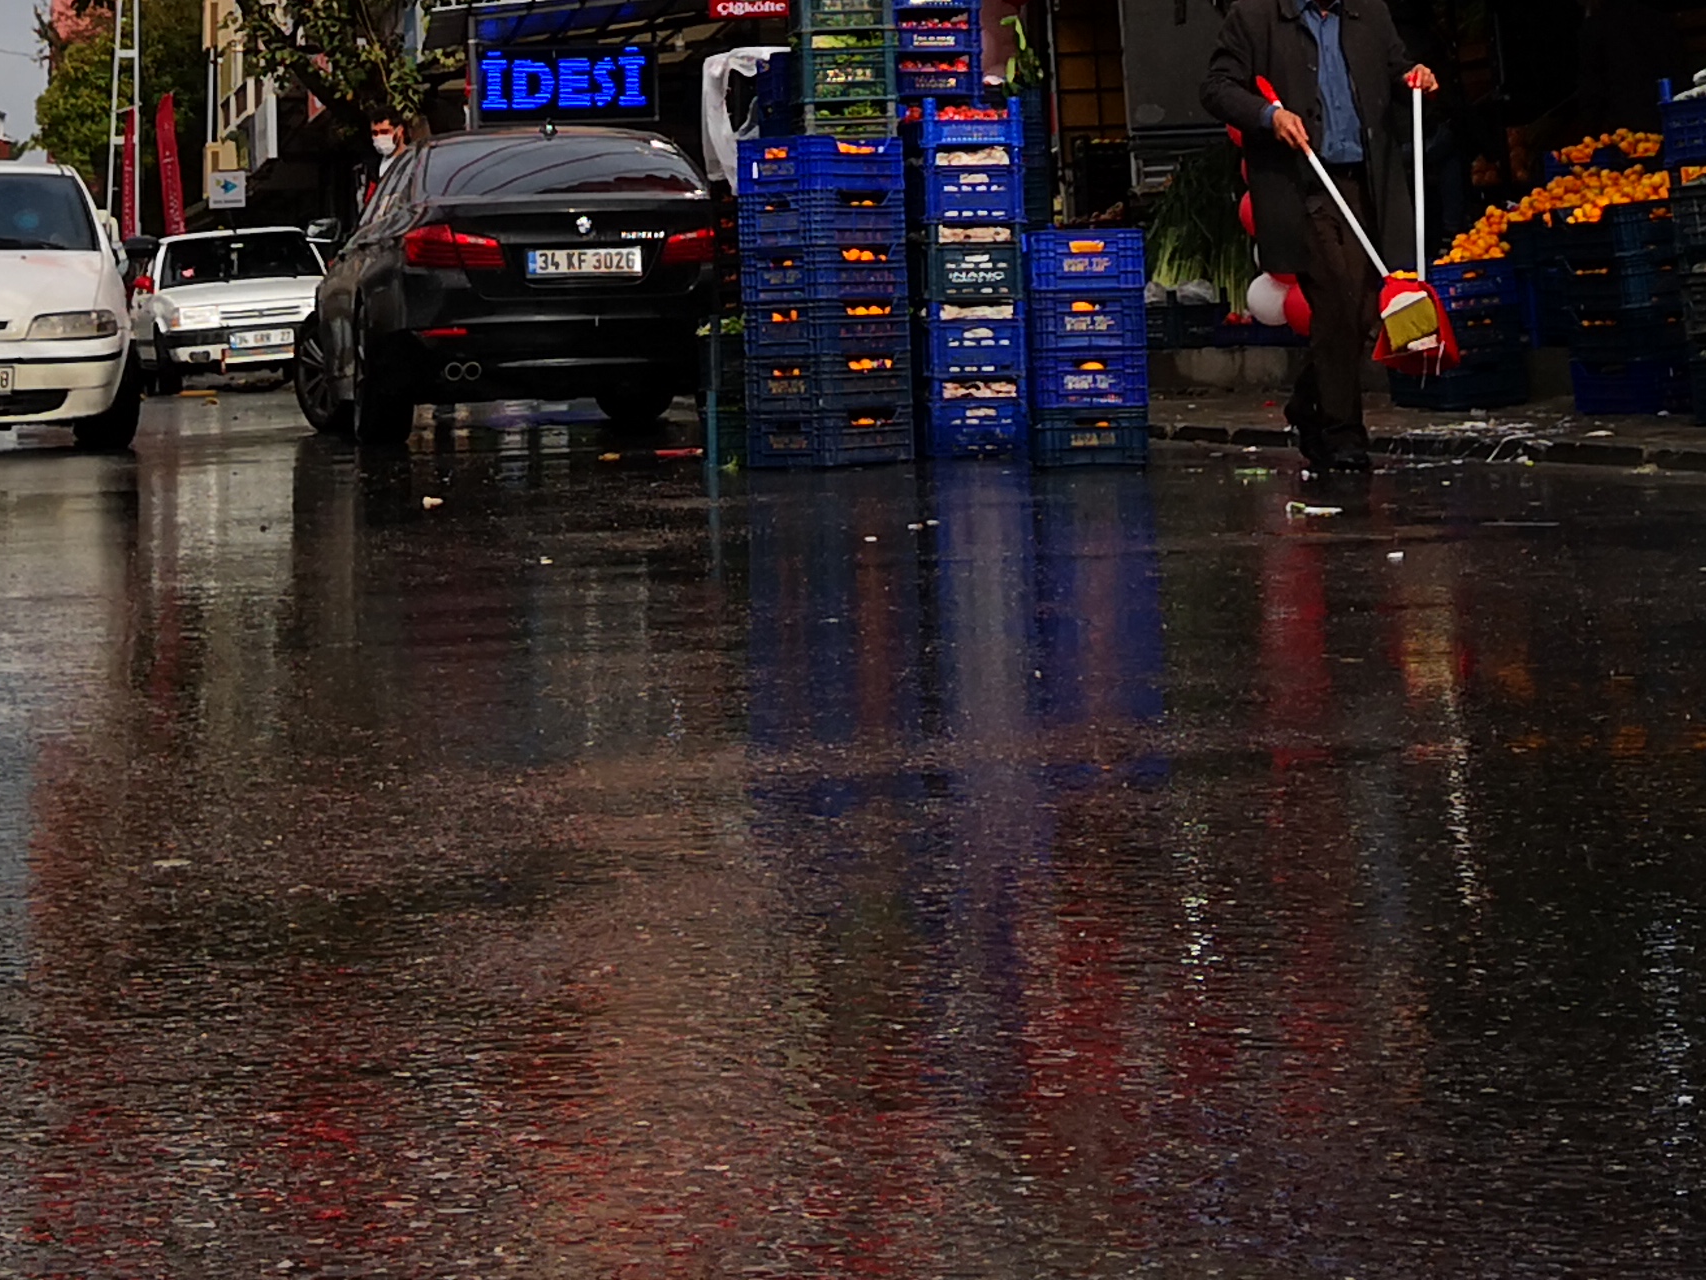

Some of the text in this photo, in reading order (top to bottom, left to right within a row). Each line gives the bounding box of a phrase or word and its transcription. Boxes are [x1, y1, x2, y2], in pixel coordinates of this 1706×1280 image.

[539, 251, 635, 270] 34 KF 3026
